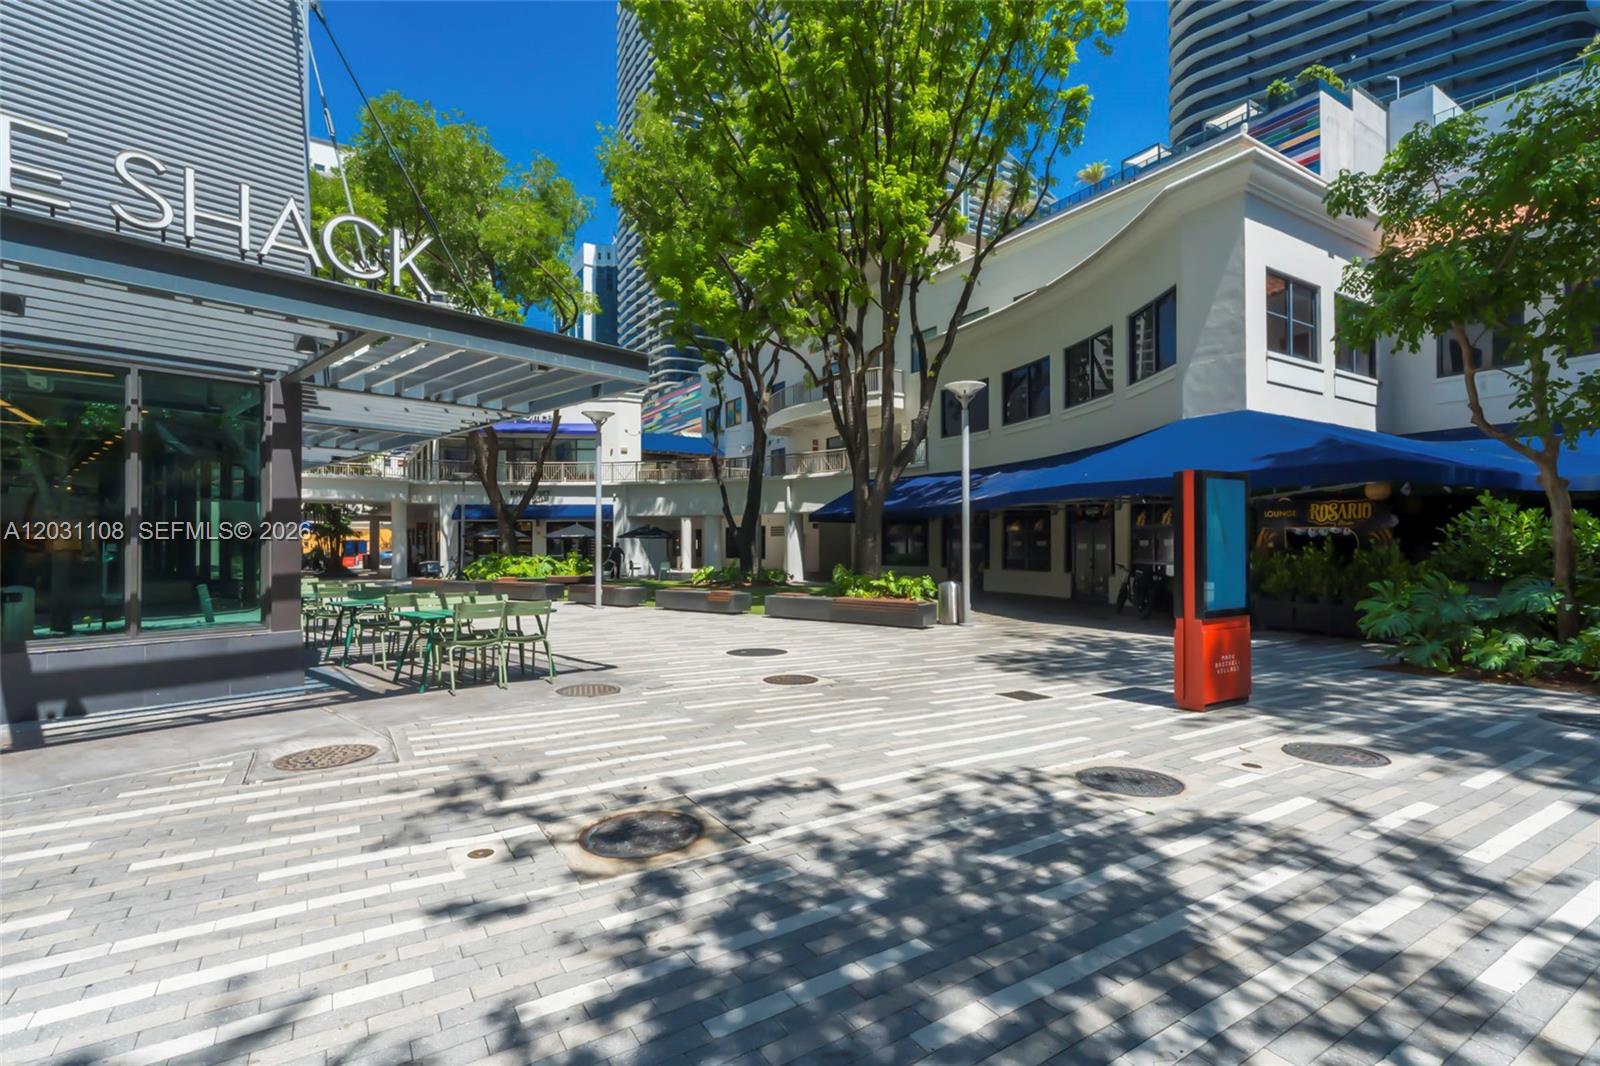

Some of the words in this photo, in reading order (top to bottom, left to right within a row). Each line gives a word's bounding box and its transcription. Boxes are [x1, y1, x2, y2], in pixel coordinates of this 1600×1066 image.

[110, 149, 438, 299] SHACK
[1264, 510, 1297, 518] LOUNGE
[1310, 502, 1373, 521] ROSARIO
